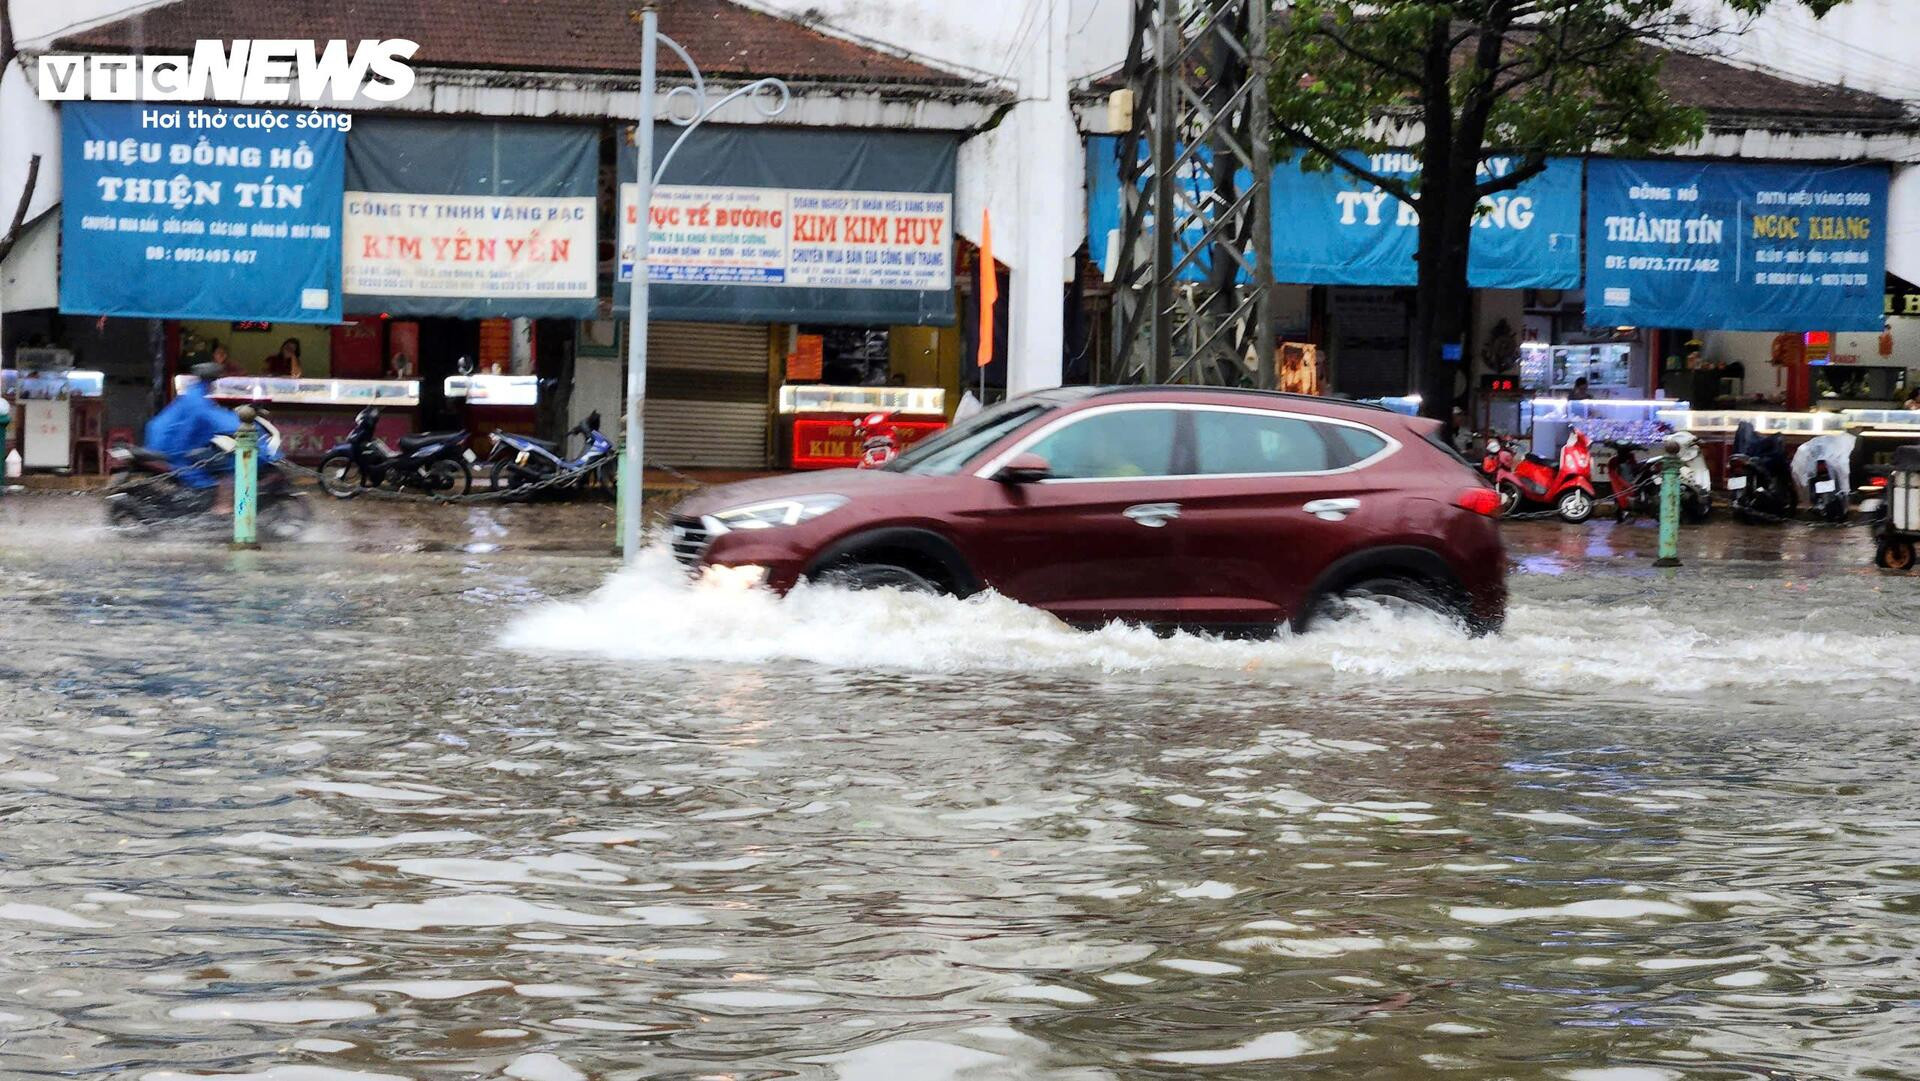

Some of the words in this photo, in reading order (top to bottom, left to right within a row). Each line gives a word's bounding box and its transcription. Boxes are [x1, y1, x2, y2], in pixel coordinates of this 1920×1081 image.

[83, 138, 162, 166] HIỆU
[270, 140, 314, 170] HỒ
[97, 173, 222, 210] THIỆN
[234, 175, 305, 209] TÍN
[408, 202, 429, 218] TY
[436, 204, 485, 220] TNHH
[686, 202, 711, 227] TẾ
[716, 204, 784, 229] ĐƯỜNG
[792, 214, 838, 242] KIM
[843, 215, 889, 244] KIM
[894, 217, 944, 245] HUY
[1684, 213, 1724, 244] TÍN
[1808, 216, 1870, 240] KHANG
[362, 232, 423, 262] KIM
[430, 226, 497, 263] YẾN
[504, 228, 572, 264] YẾN
[809, 440, 846, 458] KIM
